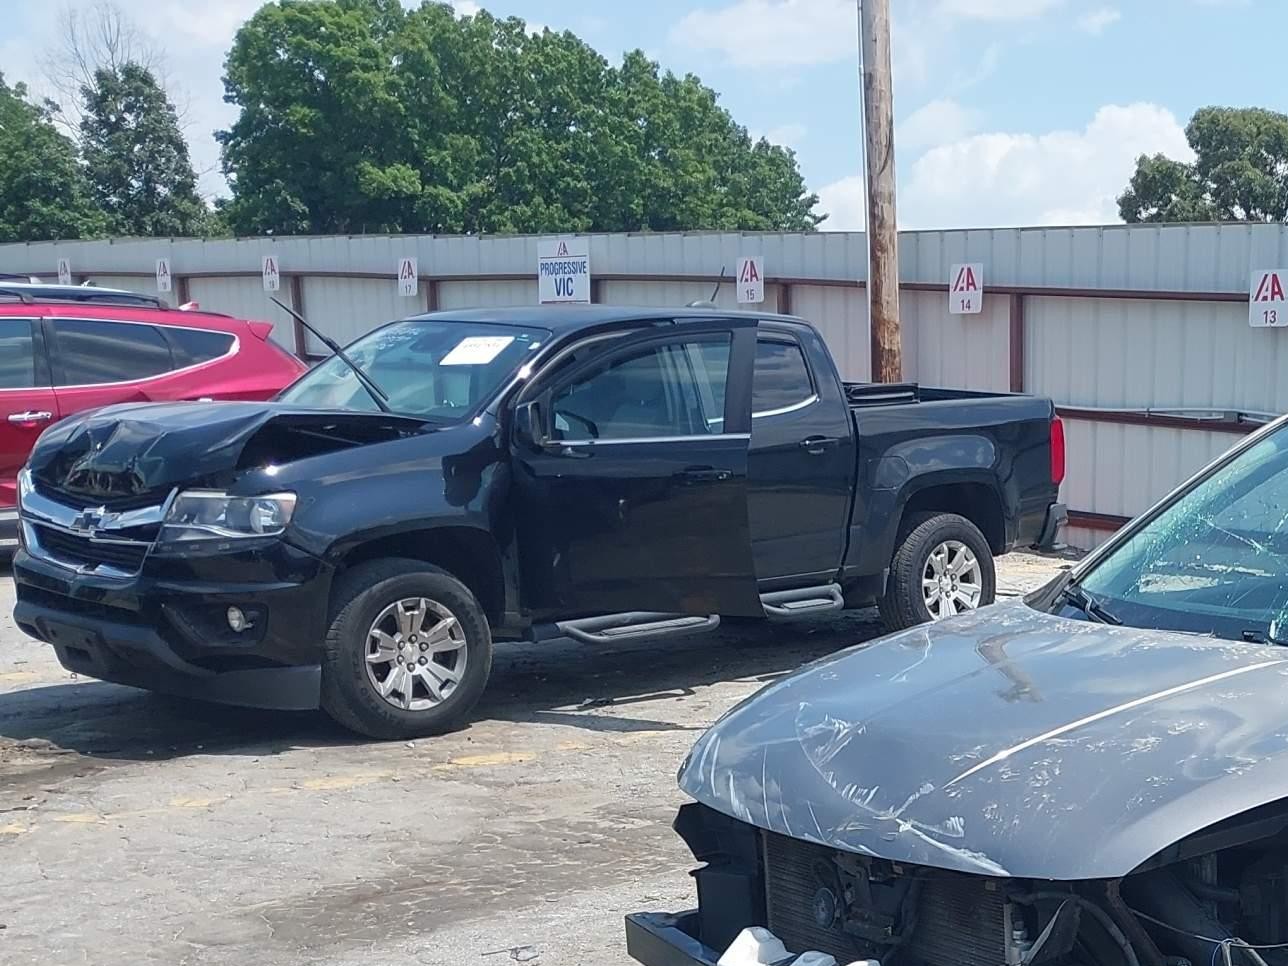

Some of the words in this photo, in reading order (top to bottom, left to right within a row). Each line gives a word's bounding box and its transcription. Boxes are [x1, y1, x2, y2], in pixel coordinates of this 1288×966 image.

[540, 261, 587, 276] PROGRESSIVE
[405, 284, 412, 294] 17
[554, 277, 574, 297] VIC
[746, 289, 755, 301] 15
[961, 299, 971, 311] 14
[1263, 310, 1277, 324] 13
